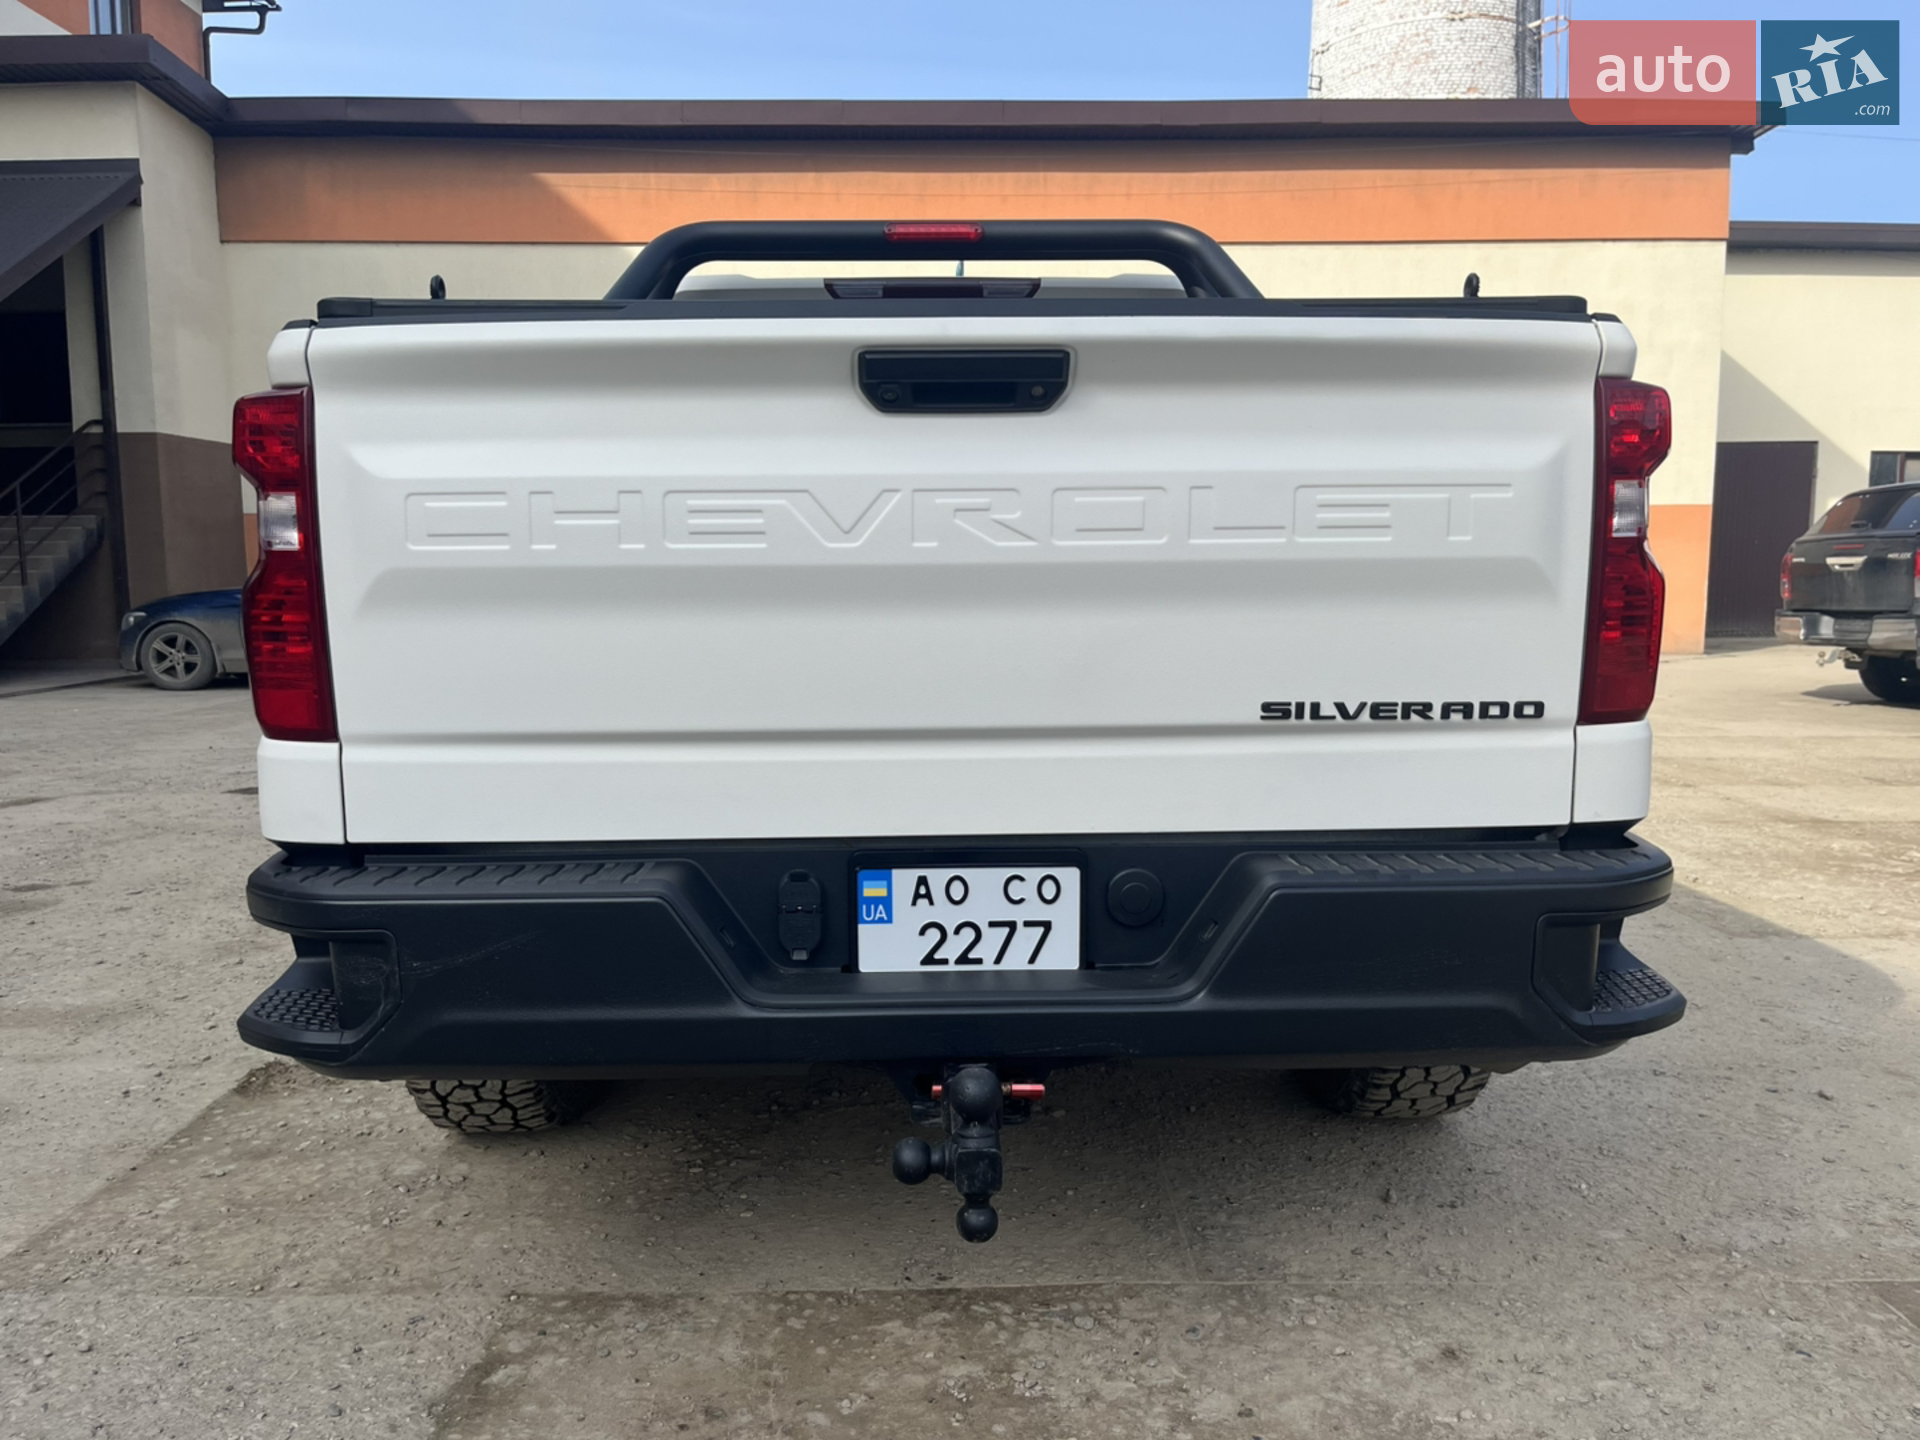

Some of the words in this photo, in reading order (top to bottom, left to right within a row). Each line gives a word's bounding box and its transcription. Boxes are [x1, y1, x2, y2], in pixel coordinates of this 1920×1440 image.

[404, 483, 1513, 550] CHEVROLET
[1260, 700, 1545, 721] SILVERADO
[910, 874, 969, 906] AO
[1003, 874, 1062, 905] CO
[862, 904, 888, 921] UA
[918, 919, 1053, 966] 2277
